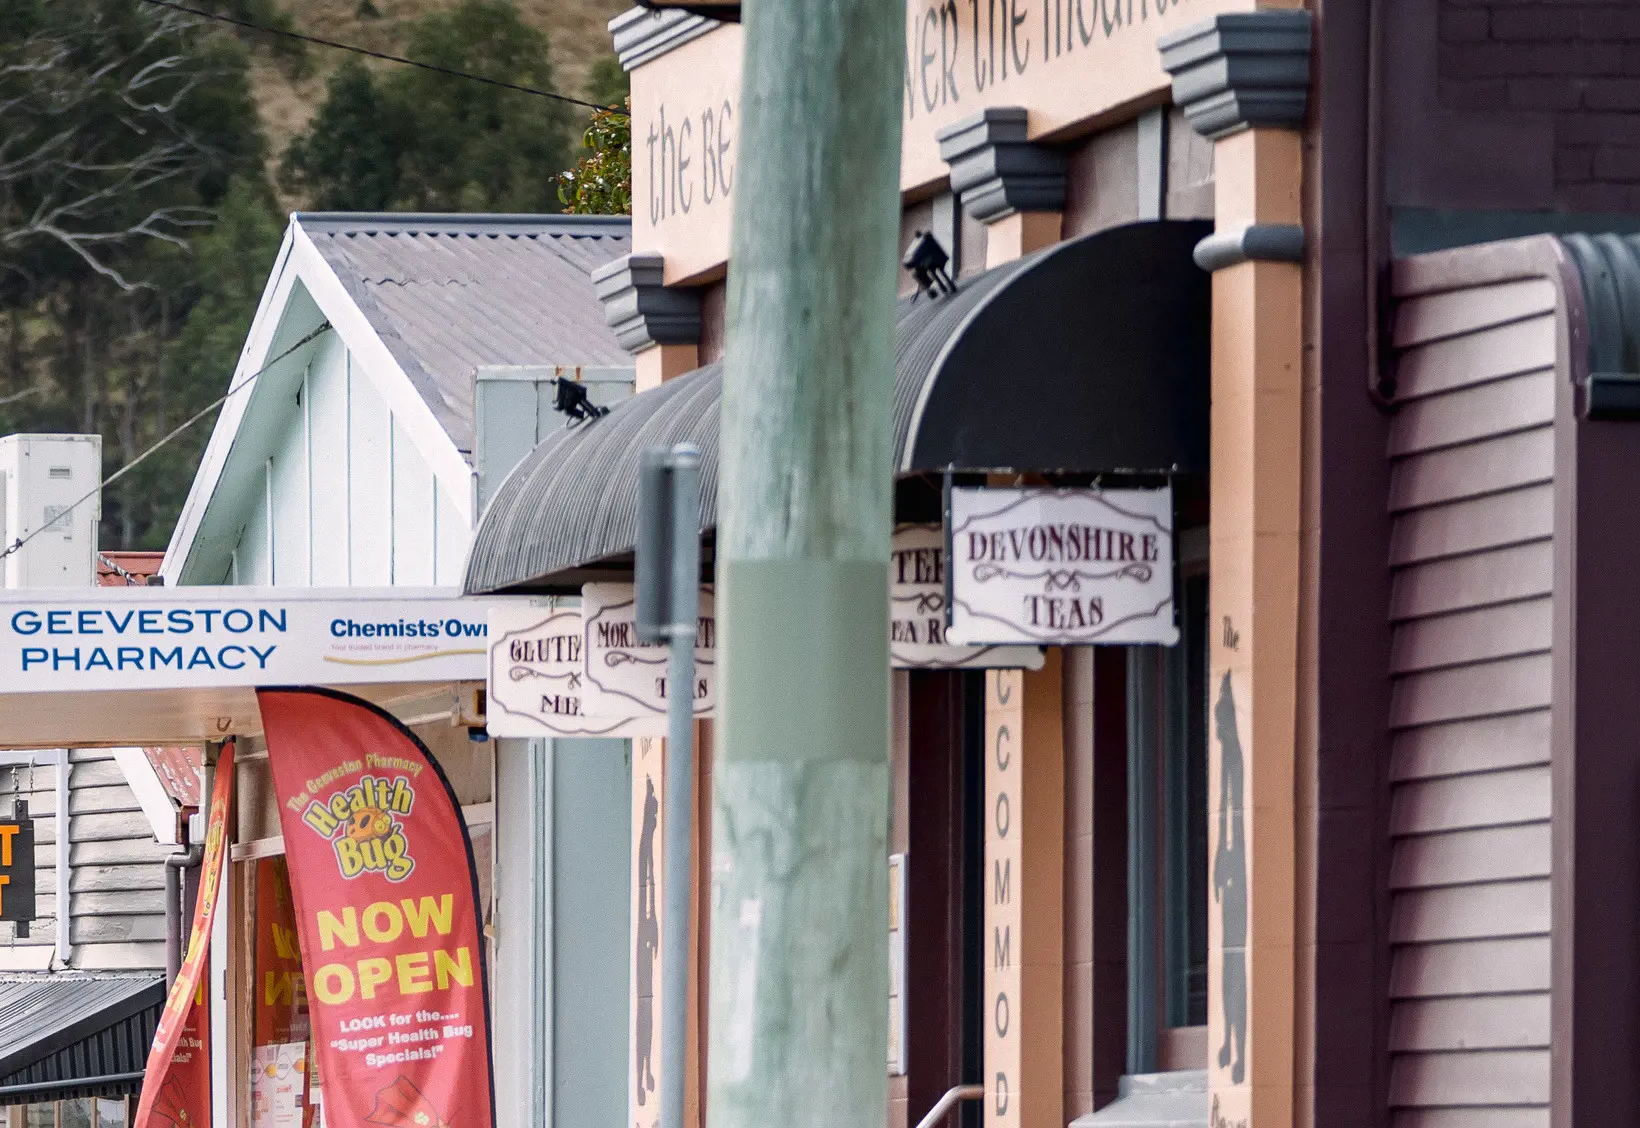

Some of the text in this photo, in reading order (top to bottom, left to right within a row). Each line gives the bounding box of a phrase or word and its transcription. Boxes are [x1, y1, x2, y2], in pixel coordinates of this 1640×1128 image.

[702, 99, 733, 205] BE
[903, 4, 960, 119] VER
[968, 523, 1159, 563] DEVONSHIRE
[11, 608, 287, 635] GEEVESTON
[1024, 594, 1103, 630] TEAS
[21, 645, 277, 671] PHARMACY
[509, 634, 582, 663] GLUTE
[306, 758, 363, 794] Geeveston
[365, 752, 424, 778] Pharmacy
[302, 775, 414, 839] Health
[334, 826, 415, 881] Bug
[317, 893, 453, 951] NOW
[313, 947, 474, 1005] OPEN
[339, 1014, 386, 1033] LOOK
[389, 1012, 413, 1027] for
[388, 1027, 439, 1045] Health
[443, 1024, 473, 1041] Bug
